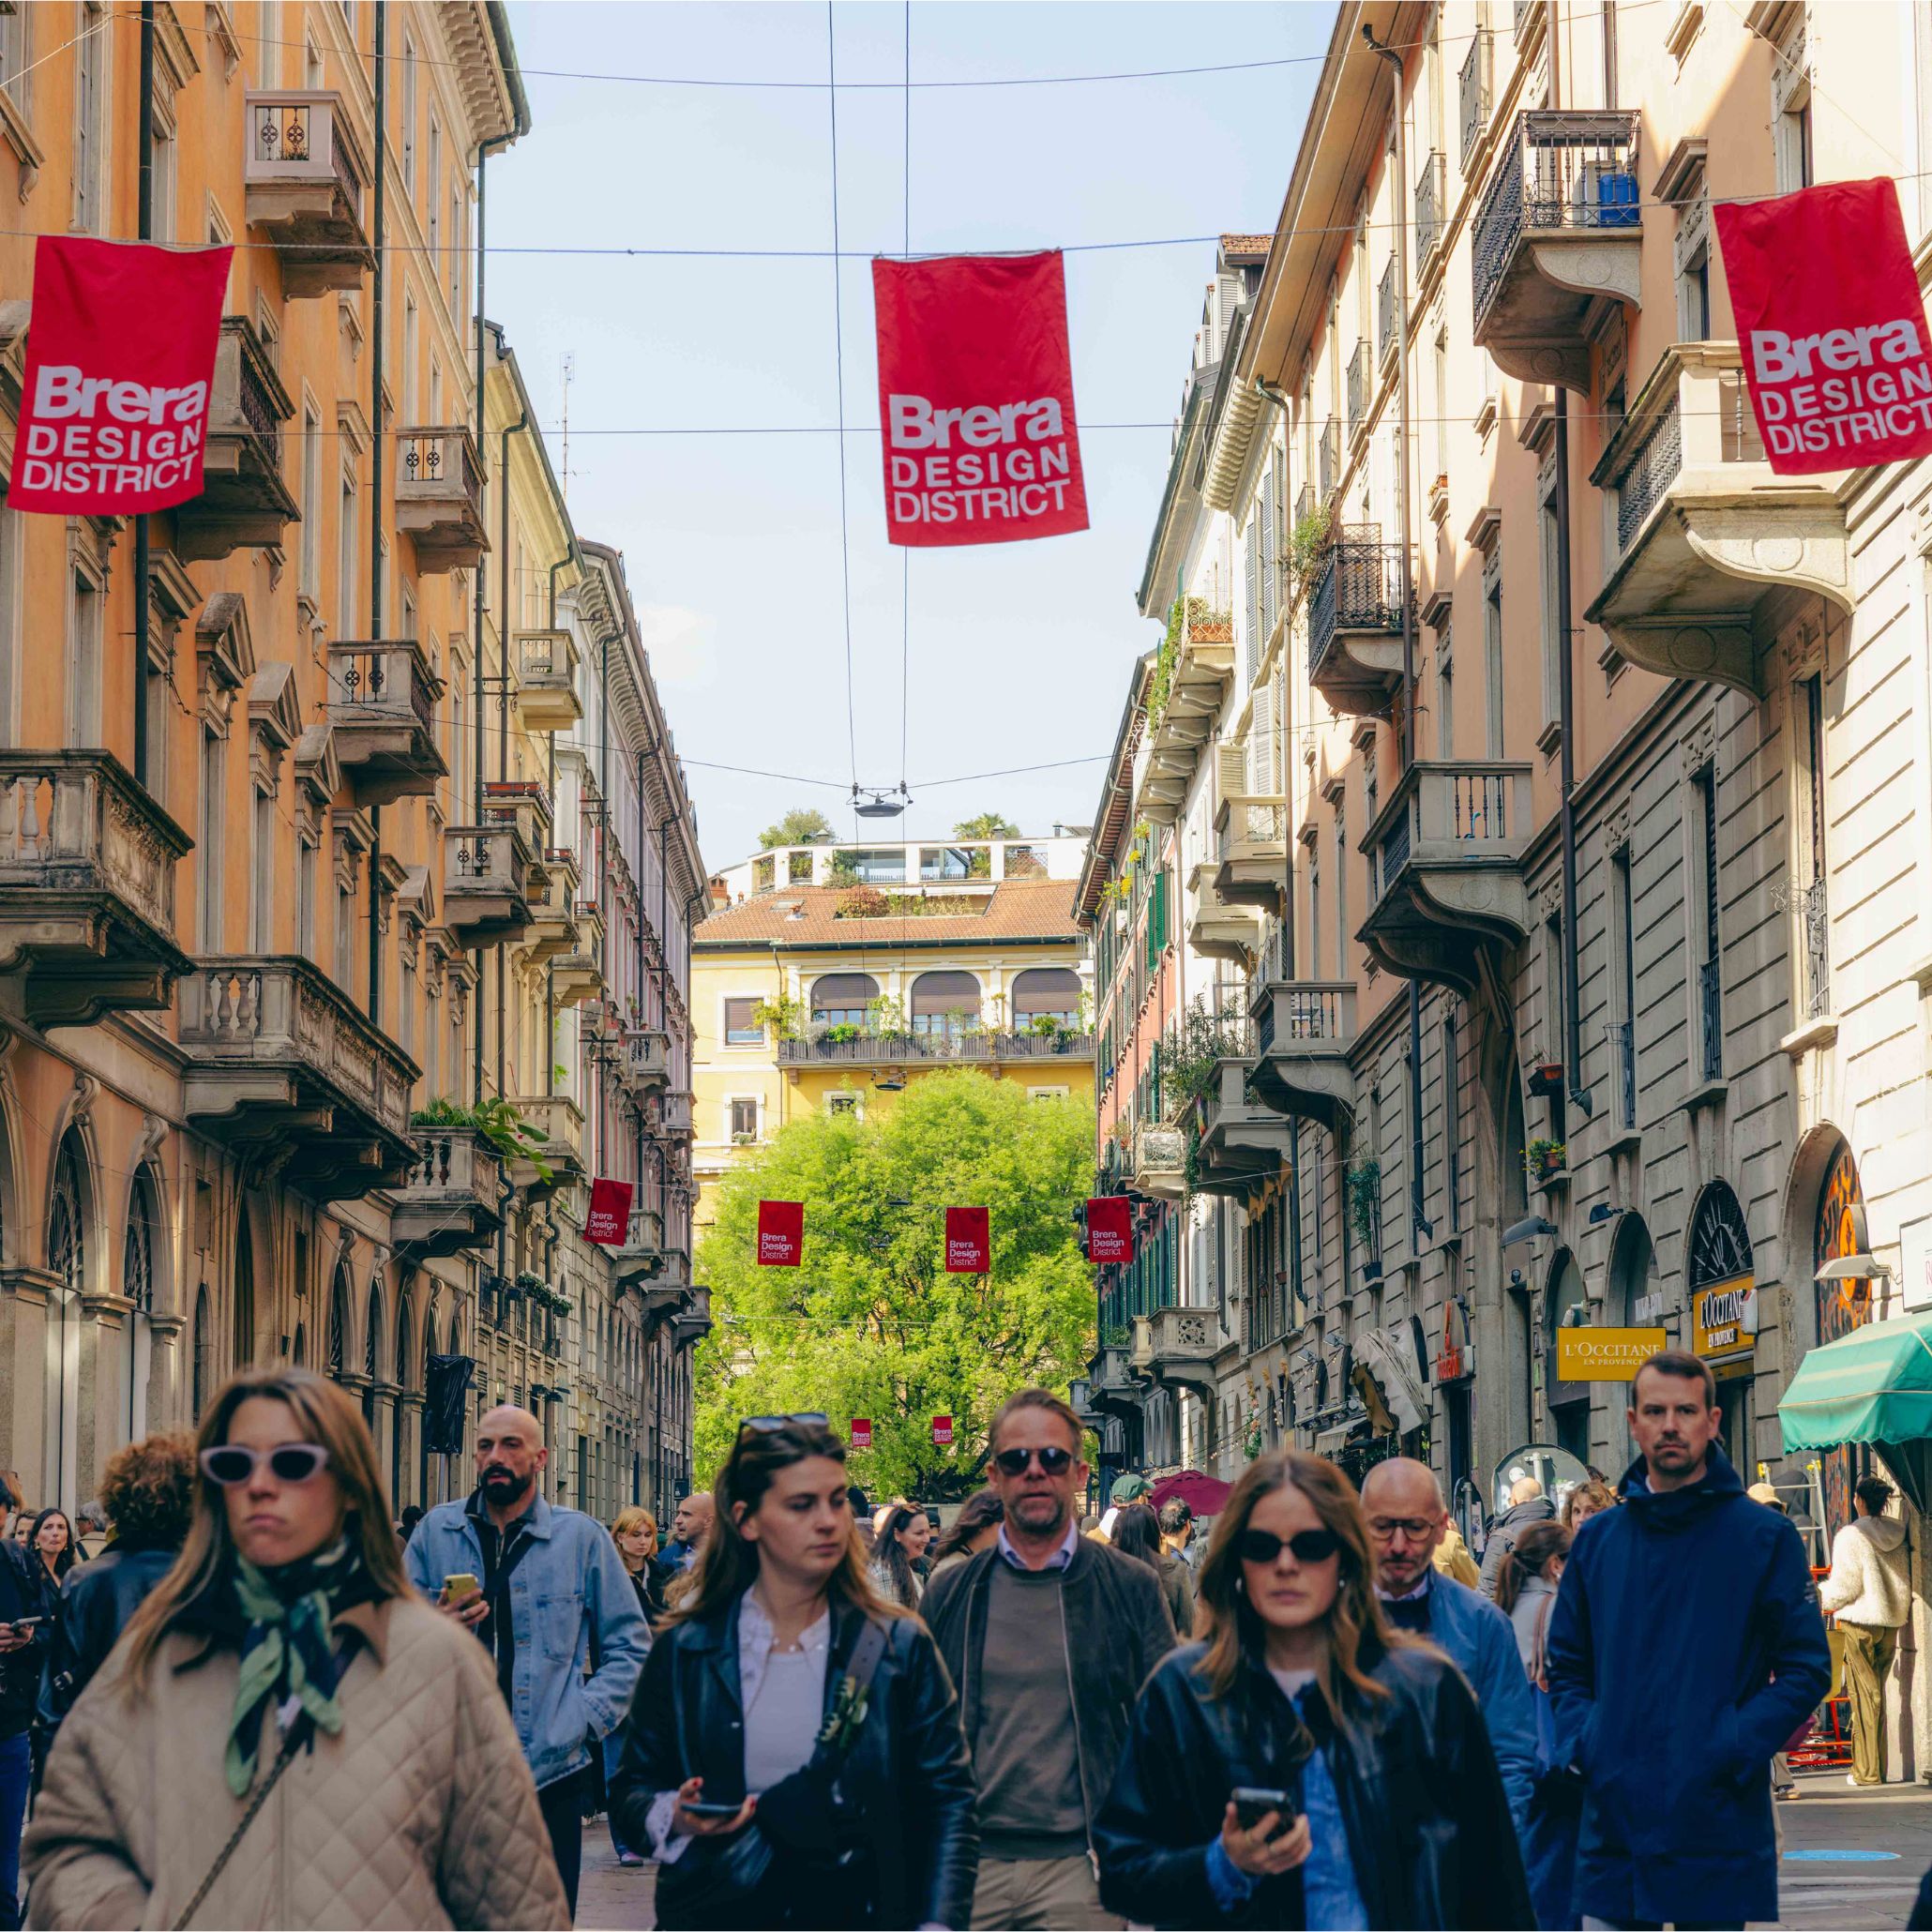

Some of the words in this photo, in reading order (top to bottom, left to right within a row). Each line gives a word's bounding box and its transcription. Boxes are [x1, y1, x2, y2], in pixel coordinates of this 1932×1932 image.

[1750, 319, 1923, 384] Brera
[33, 365, 207, 425] Brera
[1759, 362, 1932, 421] DESIGN
[888, 394, 1064, 449] Brera
[1767, 399, 1932, 454] DISTRICT
[26, 418, 203, 461] DESIGN
[891, 443, 1070, 488] DESIGN
[22, 450, 199, 493] DISTRICT
[894, 478, 1071, 523] DISTRICT
[590, 1211, 612, 1220] Brera
[589, 1219, 617, 1230] Design
[588, 1229, 614, 1238] District
[762, 1232, 787, 1242] Brera
[1092, 1230, 1117, 1239] Brera
[761, 1241, 792, 1251] Design
[949, 1240, 974, 1249] Brera
[1093, 1238, 1124, 1248] Design
[761, 1250, 789, 1260] District
[949, 1248, 981, 1259] Design
[1093, 1247, 1122, 1257] District
[949, 1257, 977, 1266] District
